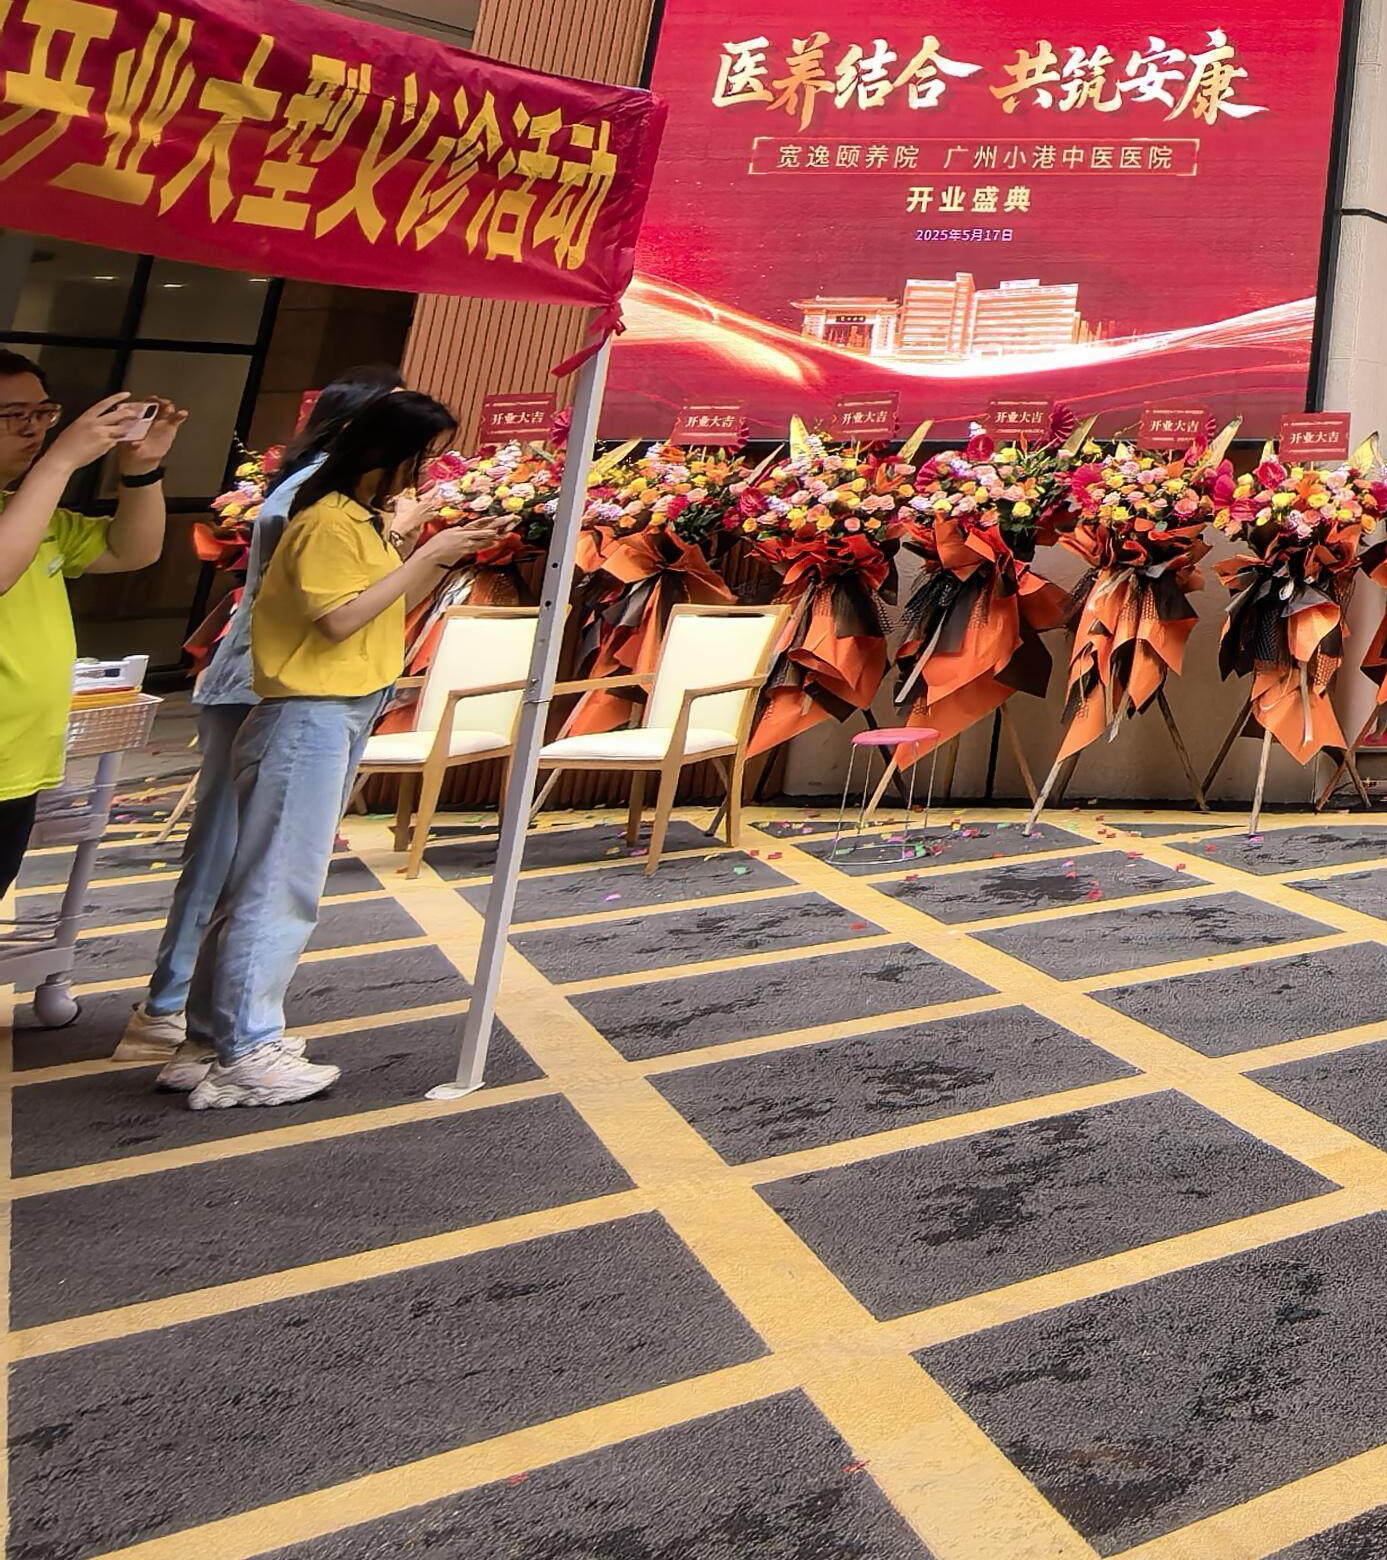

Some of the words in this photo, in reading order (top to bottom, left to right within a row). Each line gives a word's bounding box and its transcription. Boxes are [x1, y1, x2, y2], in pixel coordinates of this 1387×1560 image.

[711, 30, 981, 132] 医养结合
[988, 27, 1270, 124] 共筑安康
[776, 143, 920, 170] 宽逸颐养院
[943, 144, 1173, 171] 广州小港中医医院
[906, 186, 1032, 214] 开业盛典
[915, 228, 1013, 244] 2025年5月17日
[490, 410, 545, 425] 开业大吉
[686, 415, 736, 430] 开业大吉
[840, 411, 888, 426] 开业大吉
[994, 410, 1045, 425] 开业大吉
[1149, 418, 1200, 434] 开业大吉
[1290, 431, 1340, 447] 开业大吉
